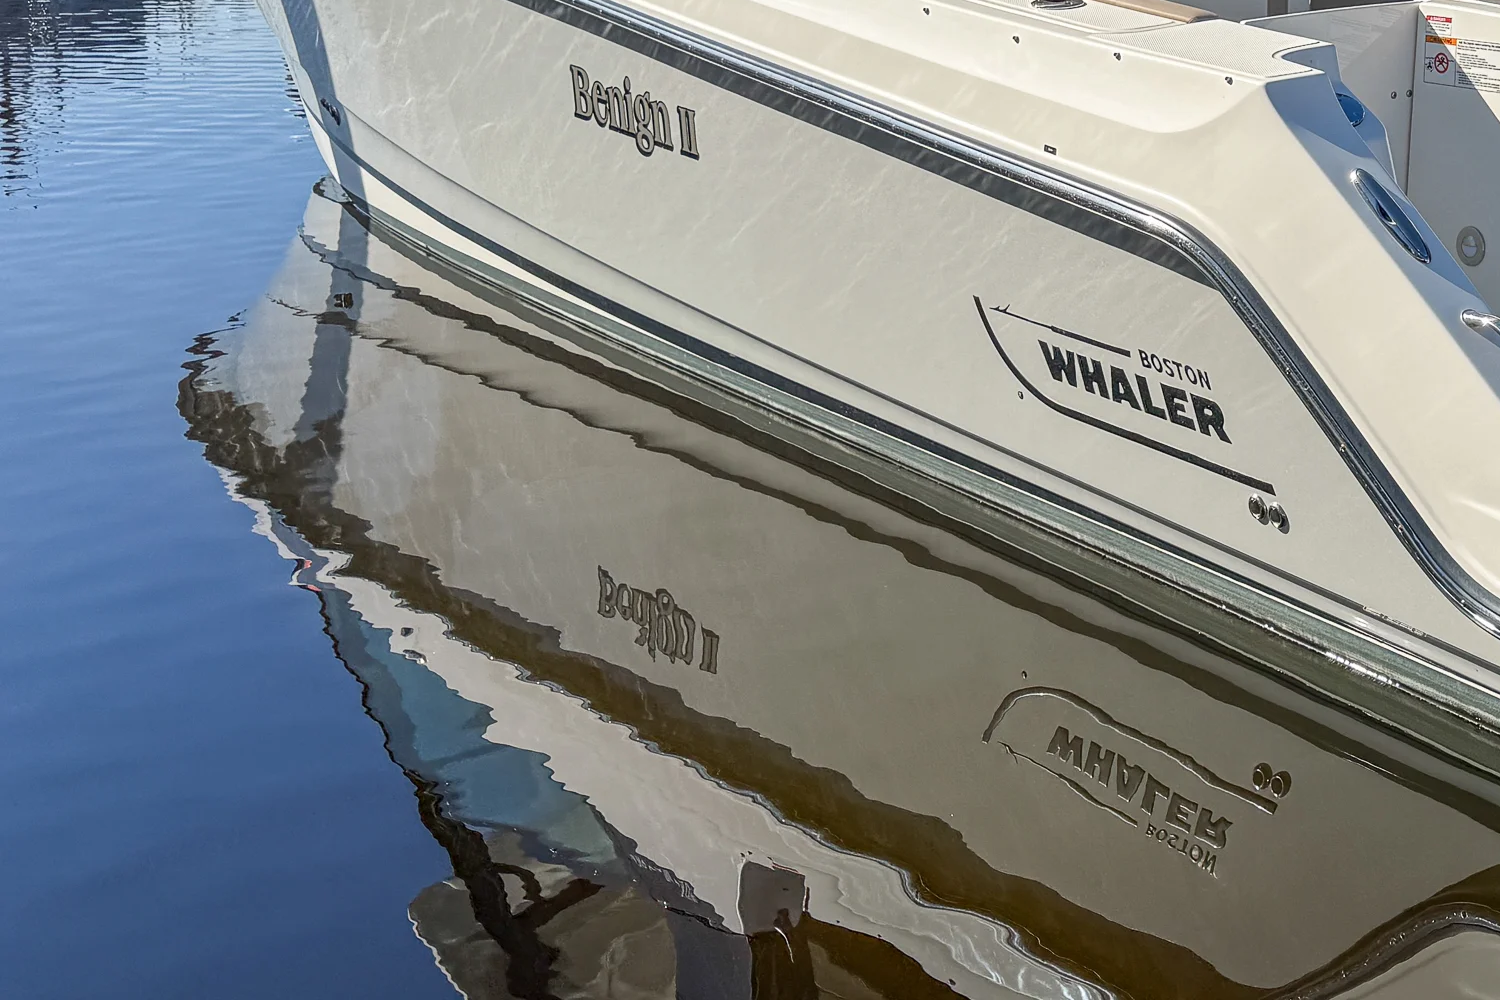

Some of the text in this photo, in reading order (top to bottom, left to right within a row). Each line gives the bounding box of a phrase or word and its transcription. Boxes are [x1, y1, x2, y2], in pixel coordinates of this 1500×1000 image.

[570, 64, 700, 161] Benign II
[1038, 339, 1233, 445] WHALER
[1138, 349, 1212, 391] BOSTON
